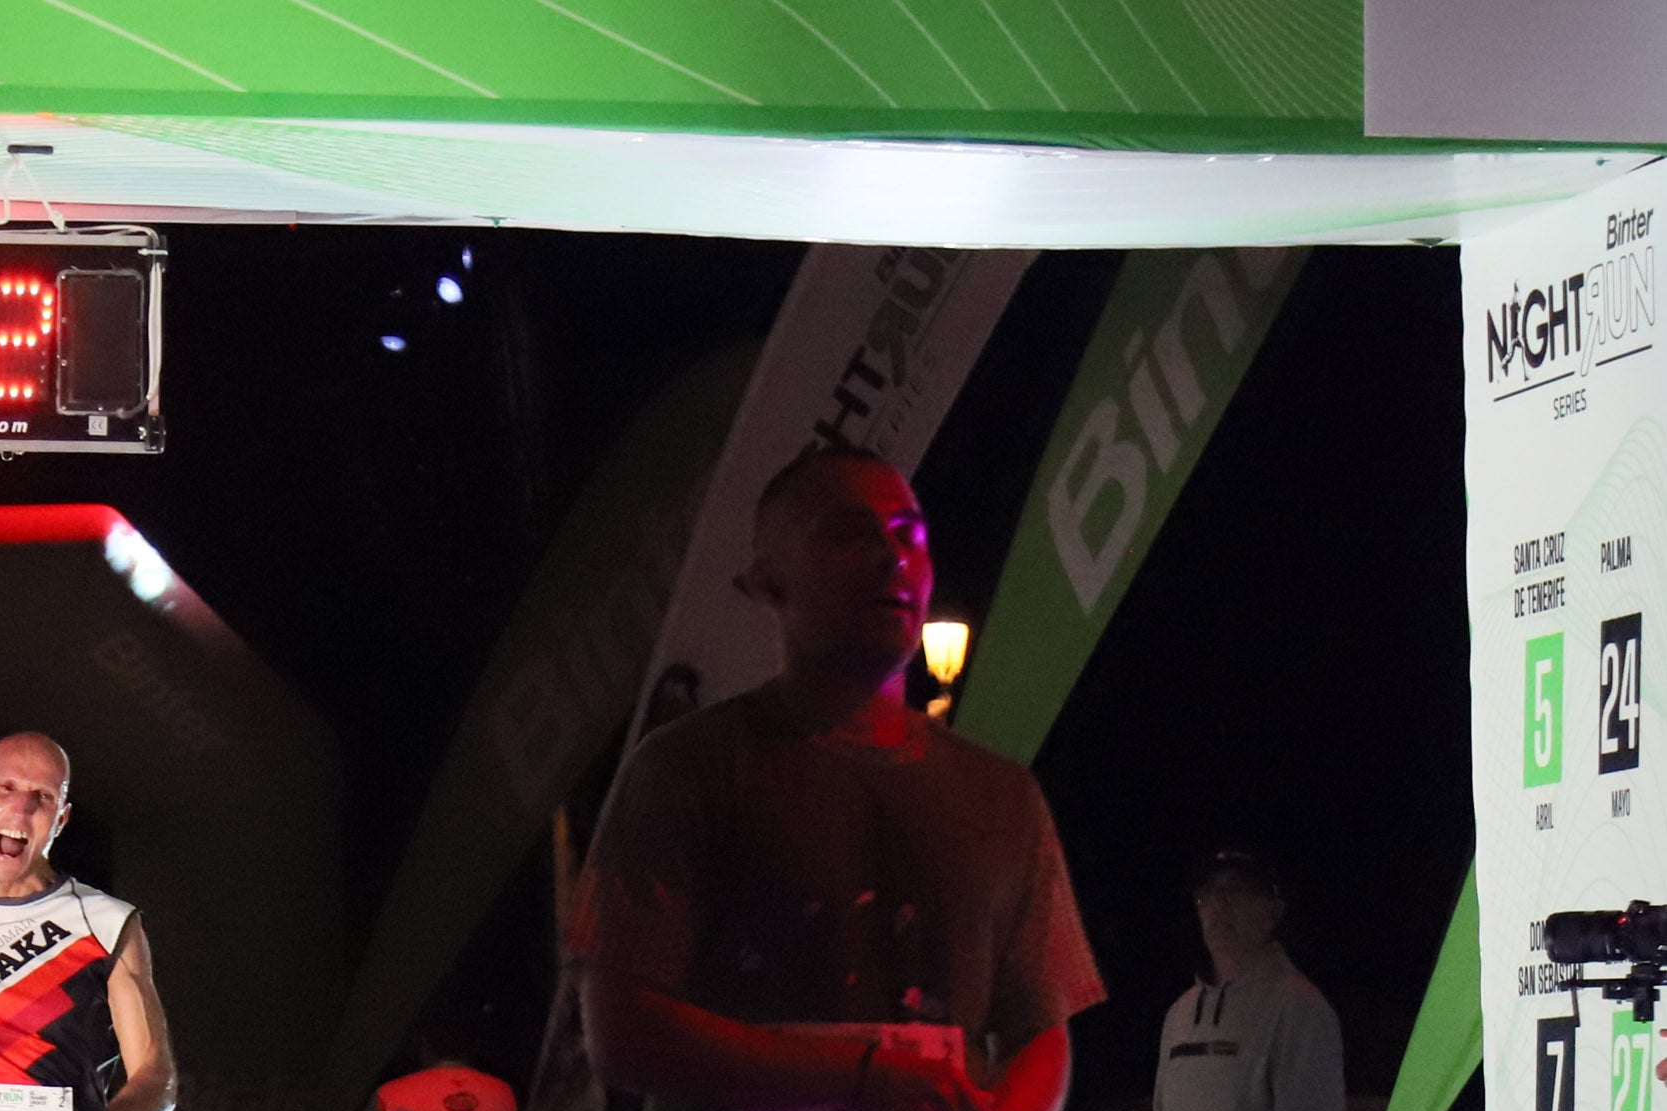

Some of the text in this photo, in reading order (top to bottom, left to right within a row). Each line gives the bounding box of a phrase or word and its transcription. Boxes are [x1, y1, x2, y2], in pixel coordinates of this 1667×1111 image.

[1607, 209, 1653, 250] Binter
[1553, 388, 1587, 420] SERIES
[1514, 532, 1565, 575] SANTA CRUZ
[1601, 536, 1632, 574] PALMA
[1514, 576, 1565, 618] DE TENERIFE
[1535, 658, 1552, 768] 5
[1601, 637, 1639, 755] 24
[1536, 803, 1554, 831] ABRIL
[1611, 788, 1631, 818] MAYO
[1518, 965, 1536, 996] SAN
